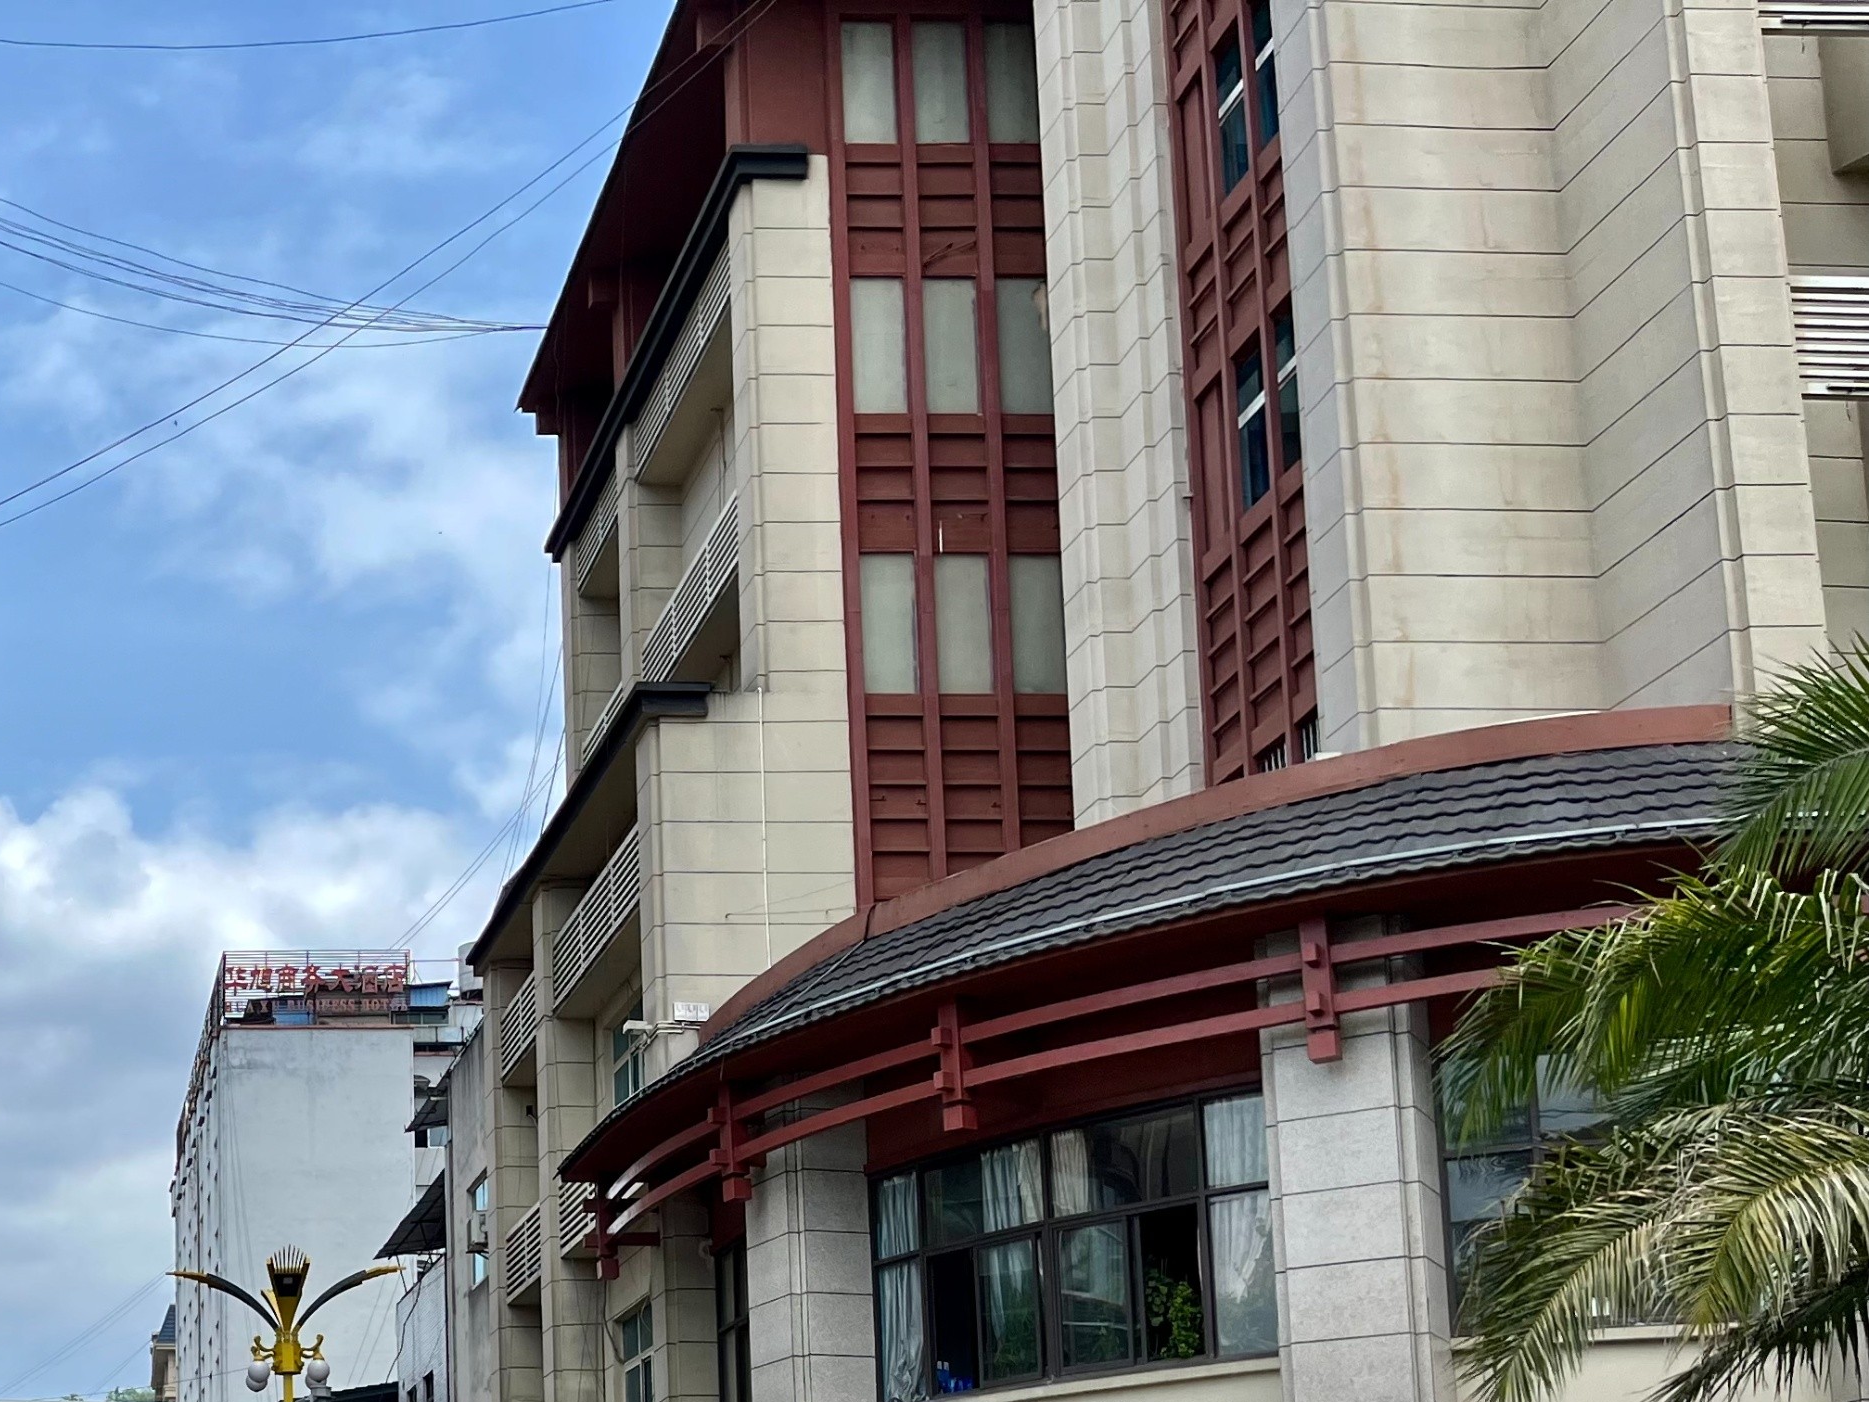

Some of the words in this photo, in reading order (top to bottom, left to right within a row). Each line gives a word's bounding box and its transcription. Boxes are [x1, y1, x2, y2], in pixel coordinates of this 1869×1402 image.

[224, 963, 407, 997] 华旭商务大酒店
